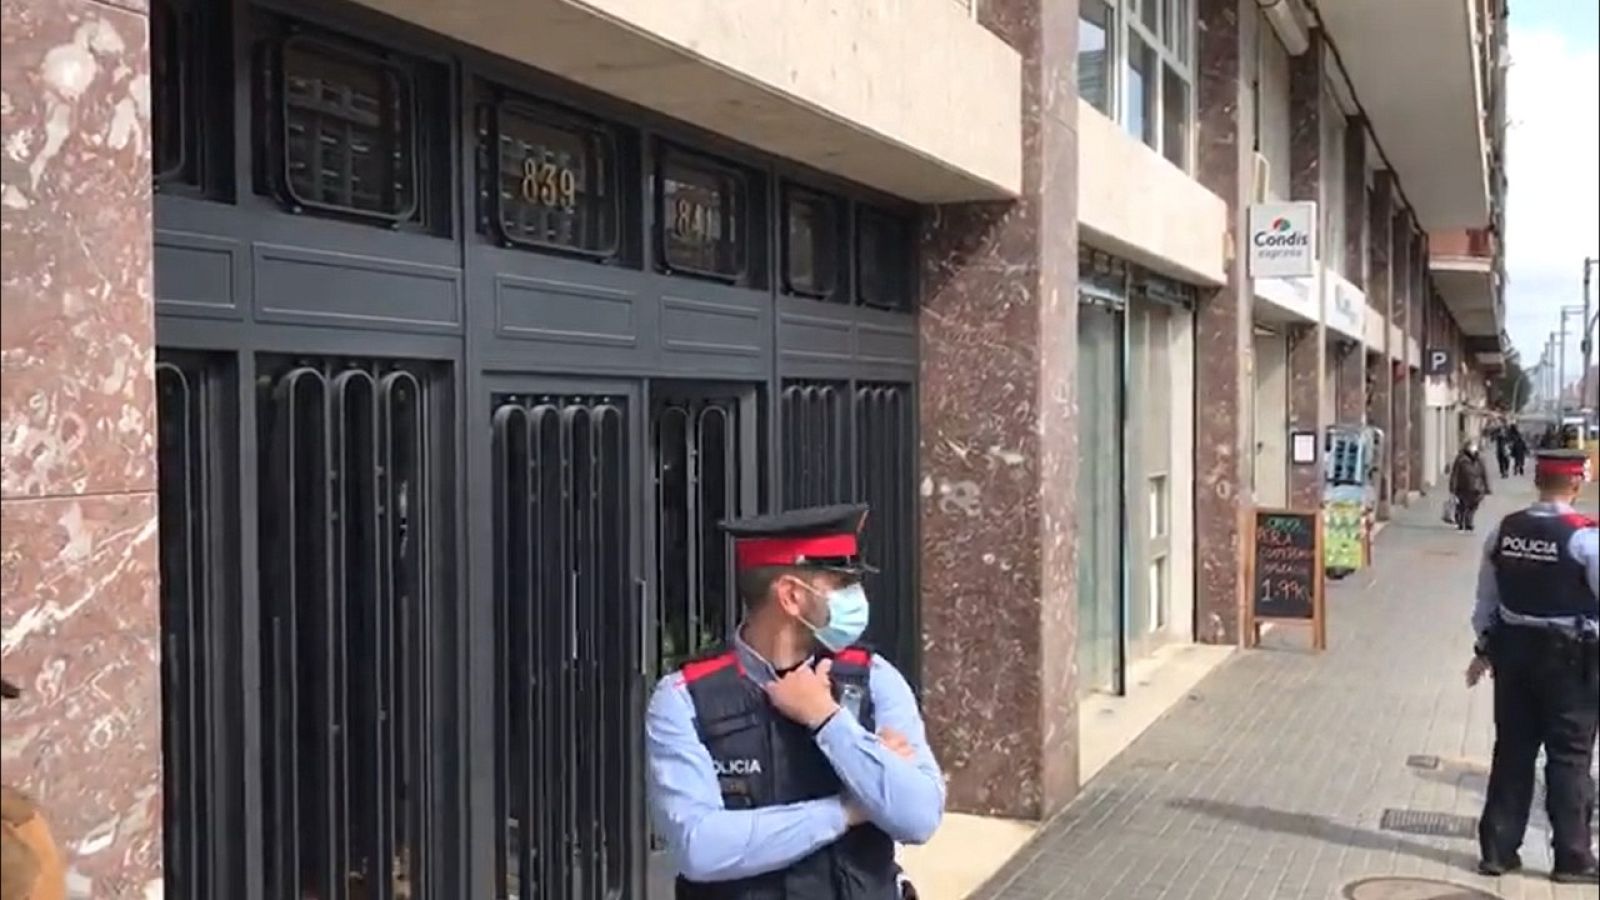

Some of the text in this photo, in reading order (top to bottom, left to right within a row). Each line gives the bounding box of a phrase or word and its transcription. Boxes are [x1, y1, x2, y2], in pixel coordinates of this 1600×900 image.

[523, 157, 576, 209] 839
[675, 199, 712, 242] 841
[1254, 231, 1309, 247] Condis
[1432, 353, 1447, 371] P
[1502, 536, 1558, 555] POLICIA
[713, 759, 762, 775] OLICIA
